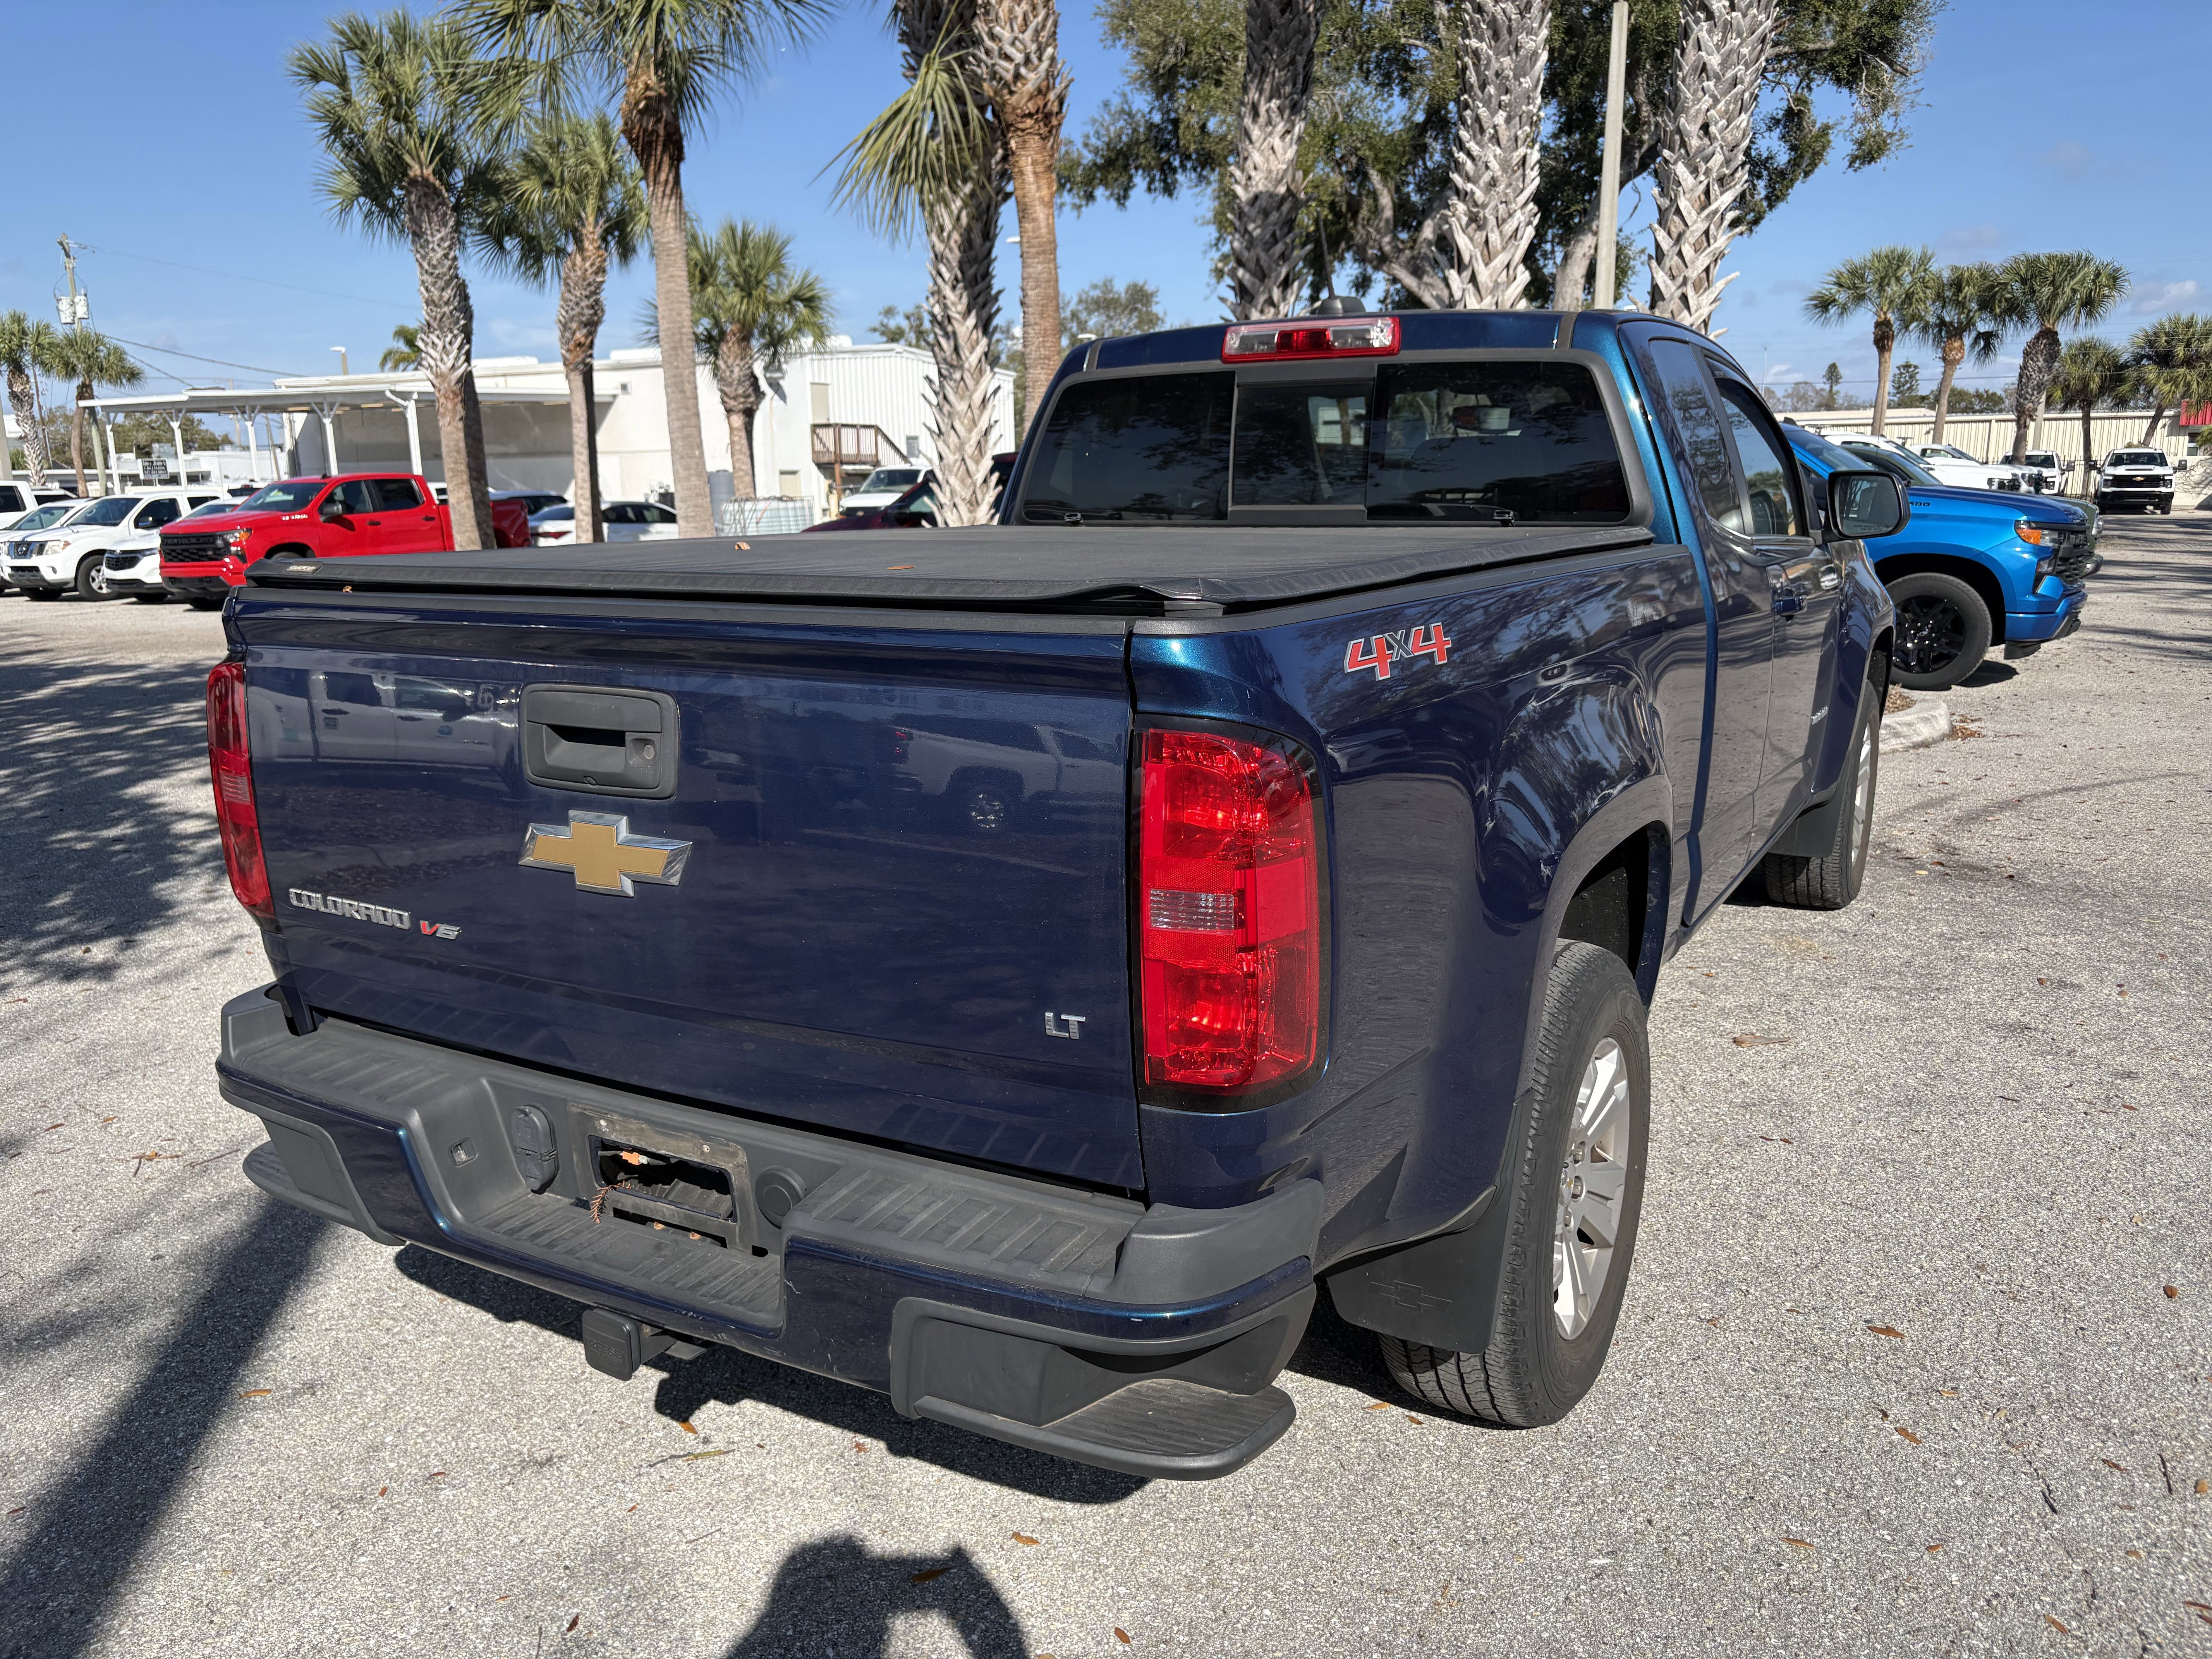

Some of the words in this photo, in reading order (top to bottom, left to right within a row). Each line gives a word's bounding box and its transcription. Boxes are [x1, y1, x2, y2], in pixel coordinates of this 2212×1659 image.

[289, 888, 412, 930] COLORADO
[420, 920, 462, 940] V6
[1045, 1012, 1086, 1039] LT
